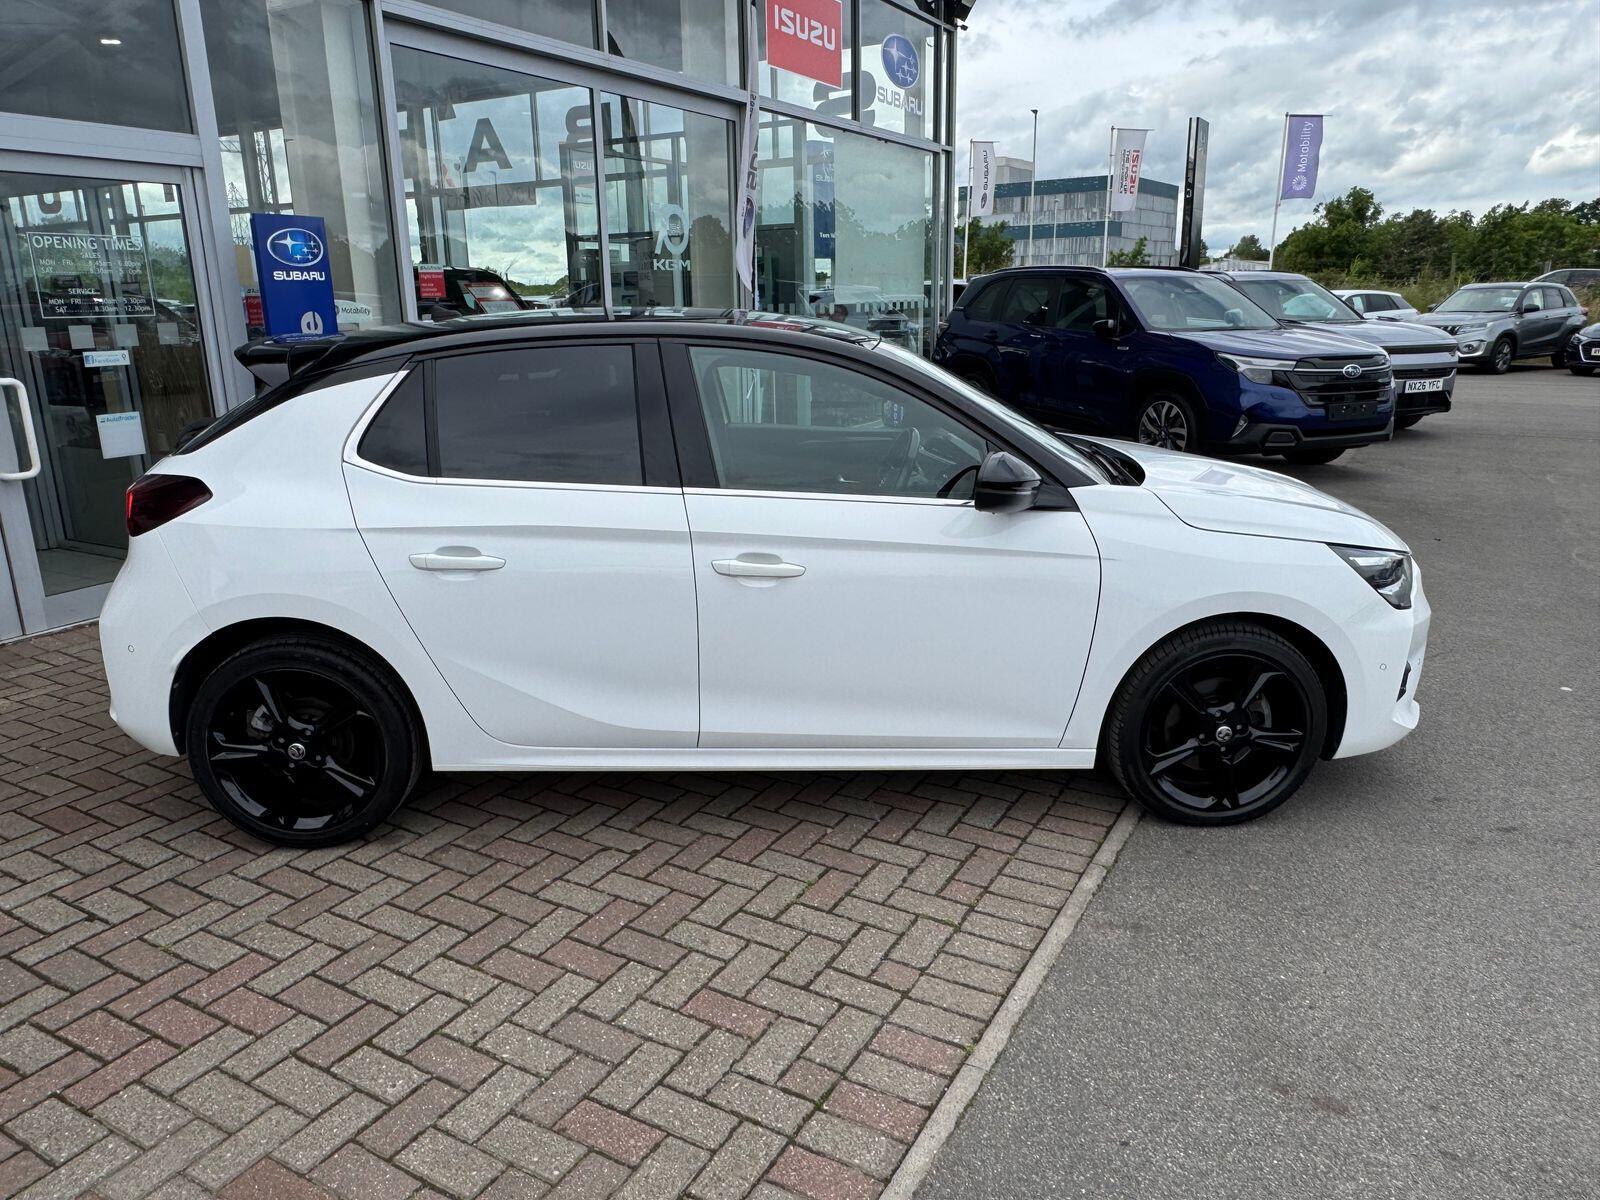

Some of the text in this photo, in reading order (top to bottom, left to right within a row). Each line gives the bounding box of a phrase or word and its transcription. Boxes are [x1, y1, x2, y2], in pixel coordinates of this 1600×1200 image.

[774, 4, 836, 51] ISUZU
[876, 85, 922, 116] SUBARU
[1297, 121, 1314, 173] Motability
[982, 149, 990, 191] SUBARU
[1129, 149, 1140, 194] ISUZU
[32, 235, 142, 251] OPENING TIMES
[273, 271, 326, 281] SUBARU
[652, 259, 691, 271] KGM
[341, 306, 371, 316] Motability
[1429, 380, 1440, 390] YFC
